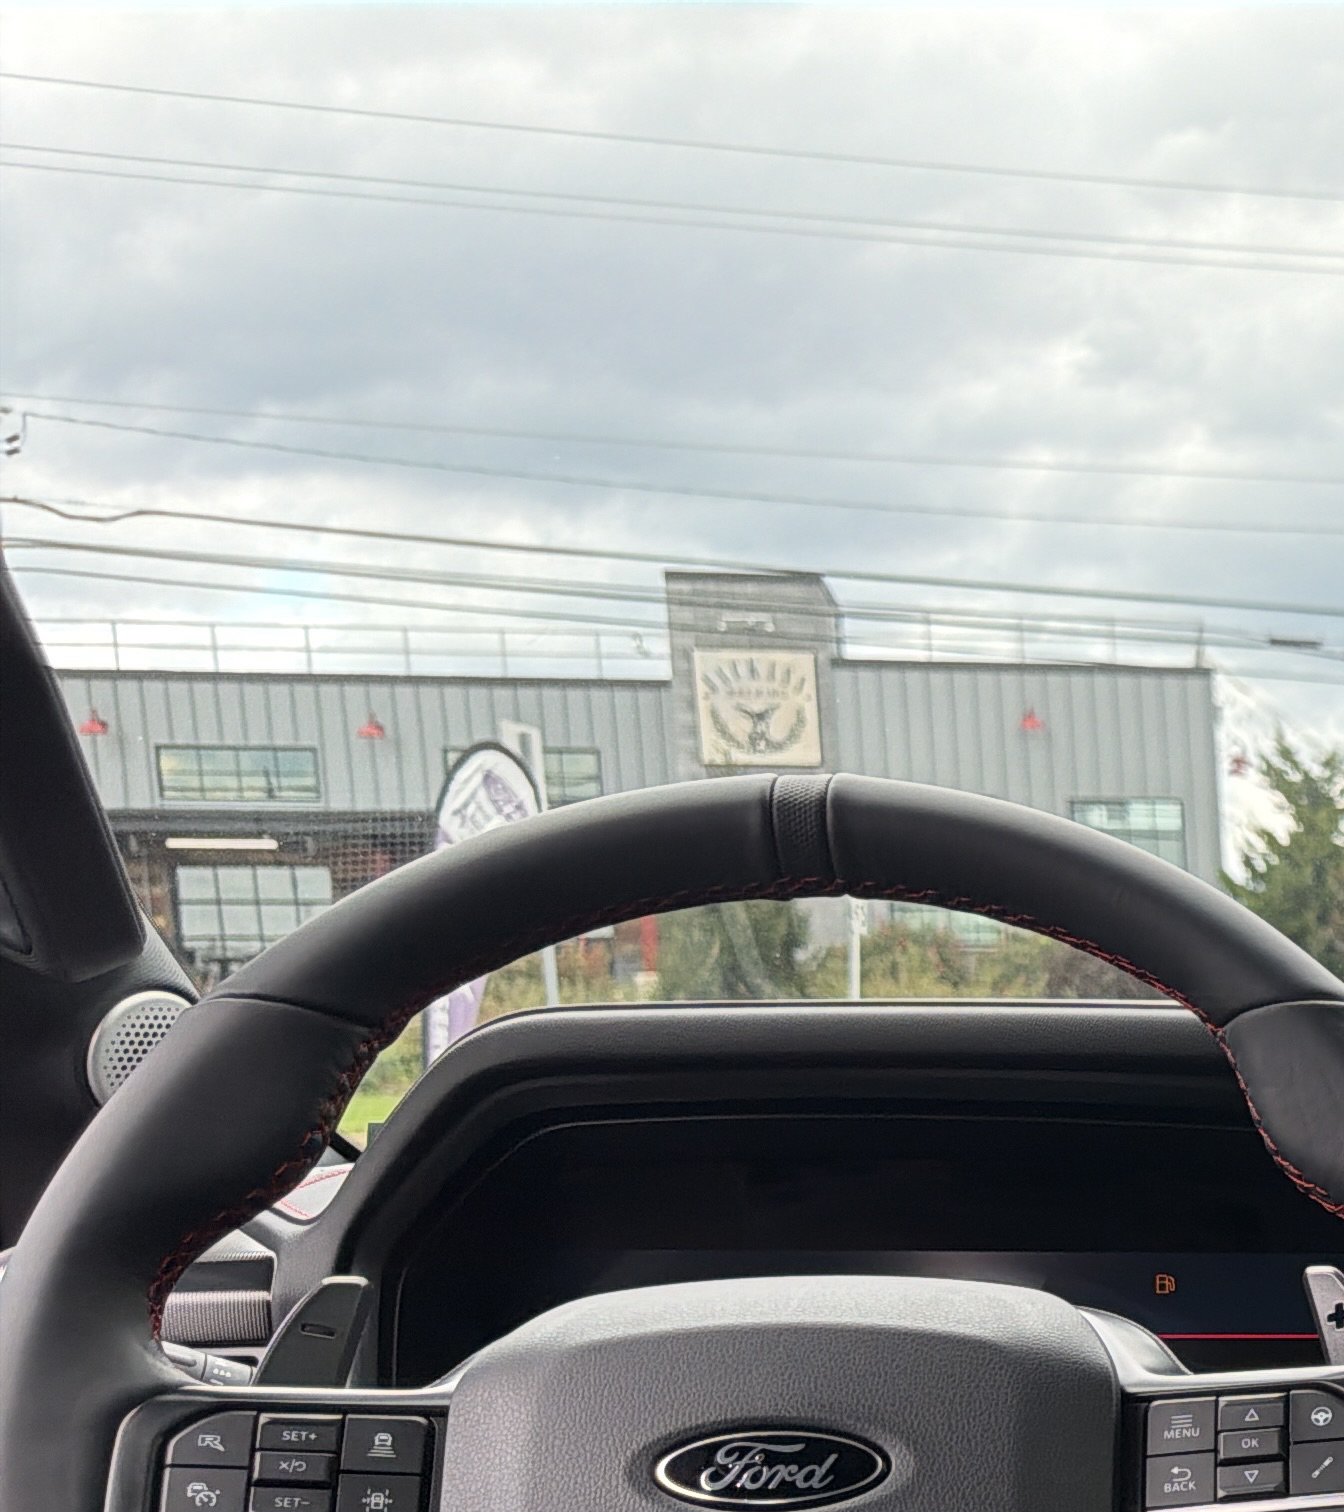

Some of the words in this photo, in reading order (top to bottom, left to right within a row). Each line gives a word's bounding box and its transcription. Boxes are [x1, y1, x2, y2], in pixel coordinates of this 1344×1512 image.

[1163, 1428, 1200, 1440] MENU
[1241, 1438, 1259, 1449] OK
[700, 1441, 838, 1491] Ford
[1163, 1481, 1197, 1493] BACK
